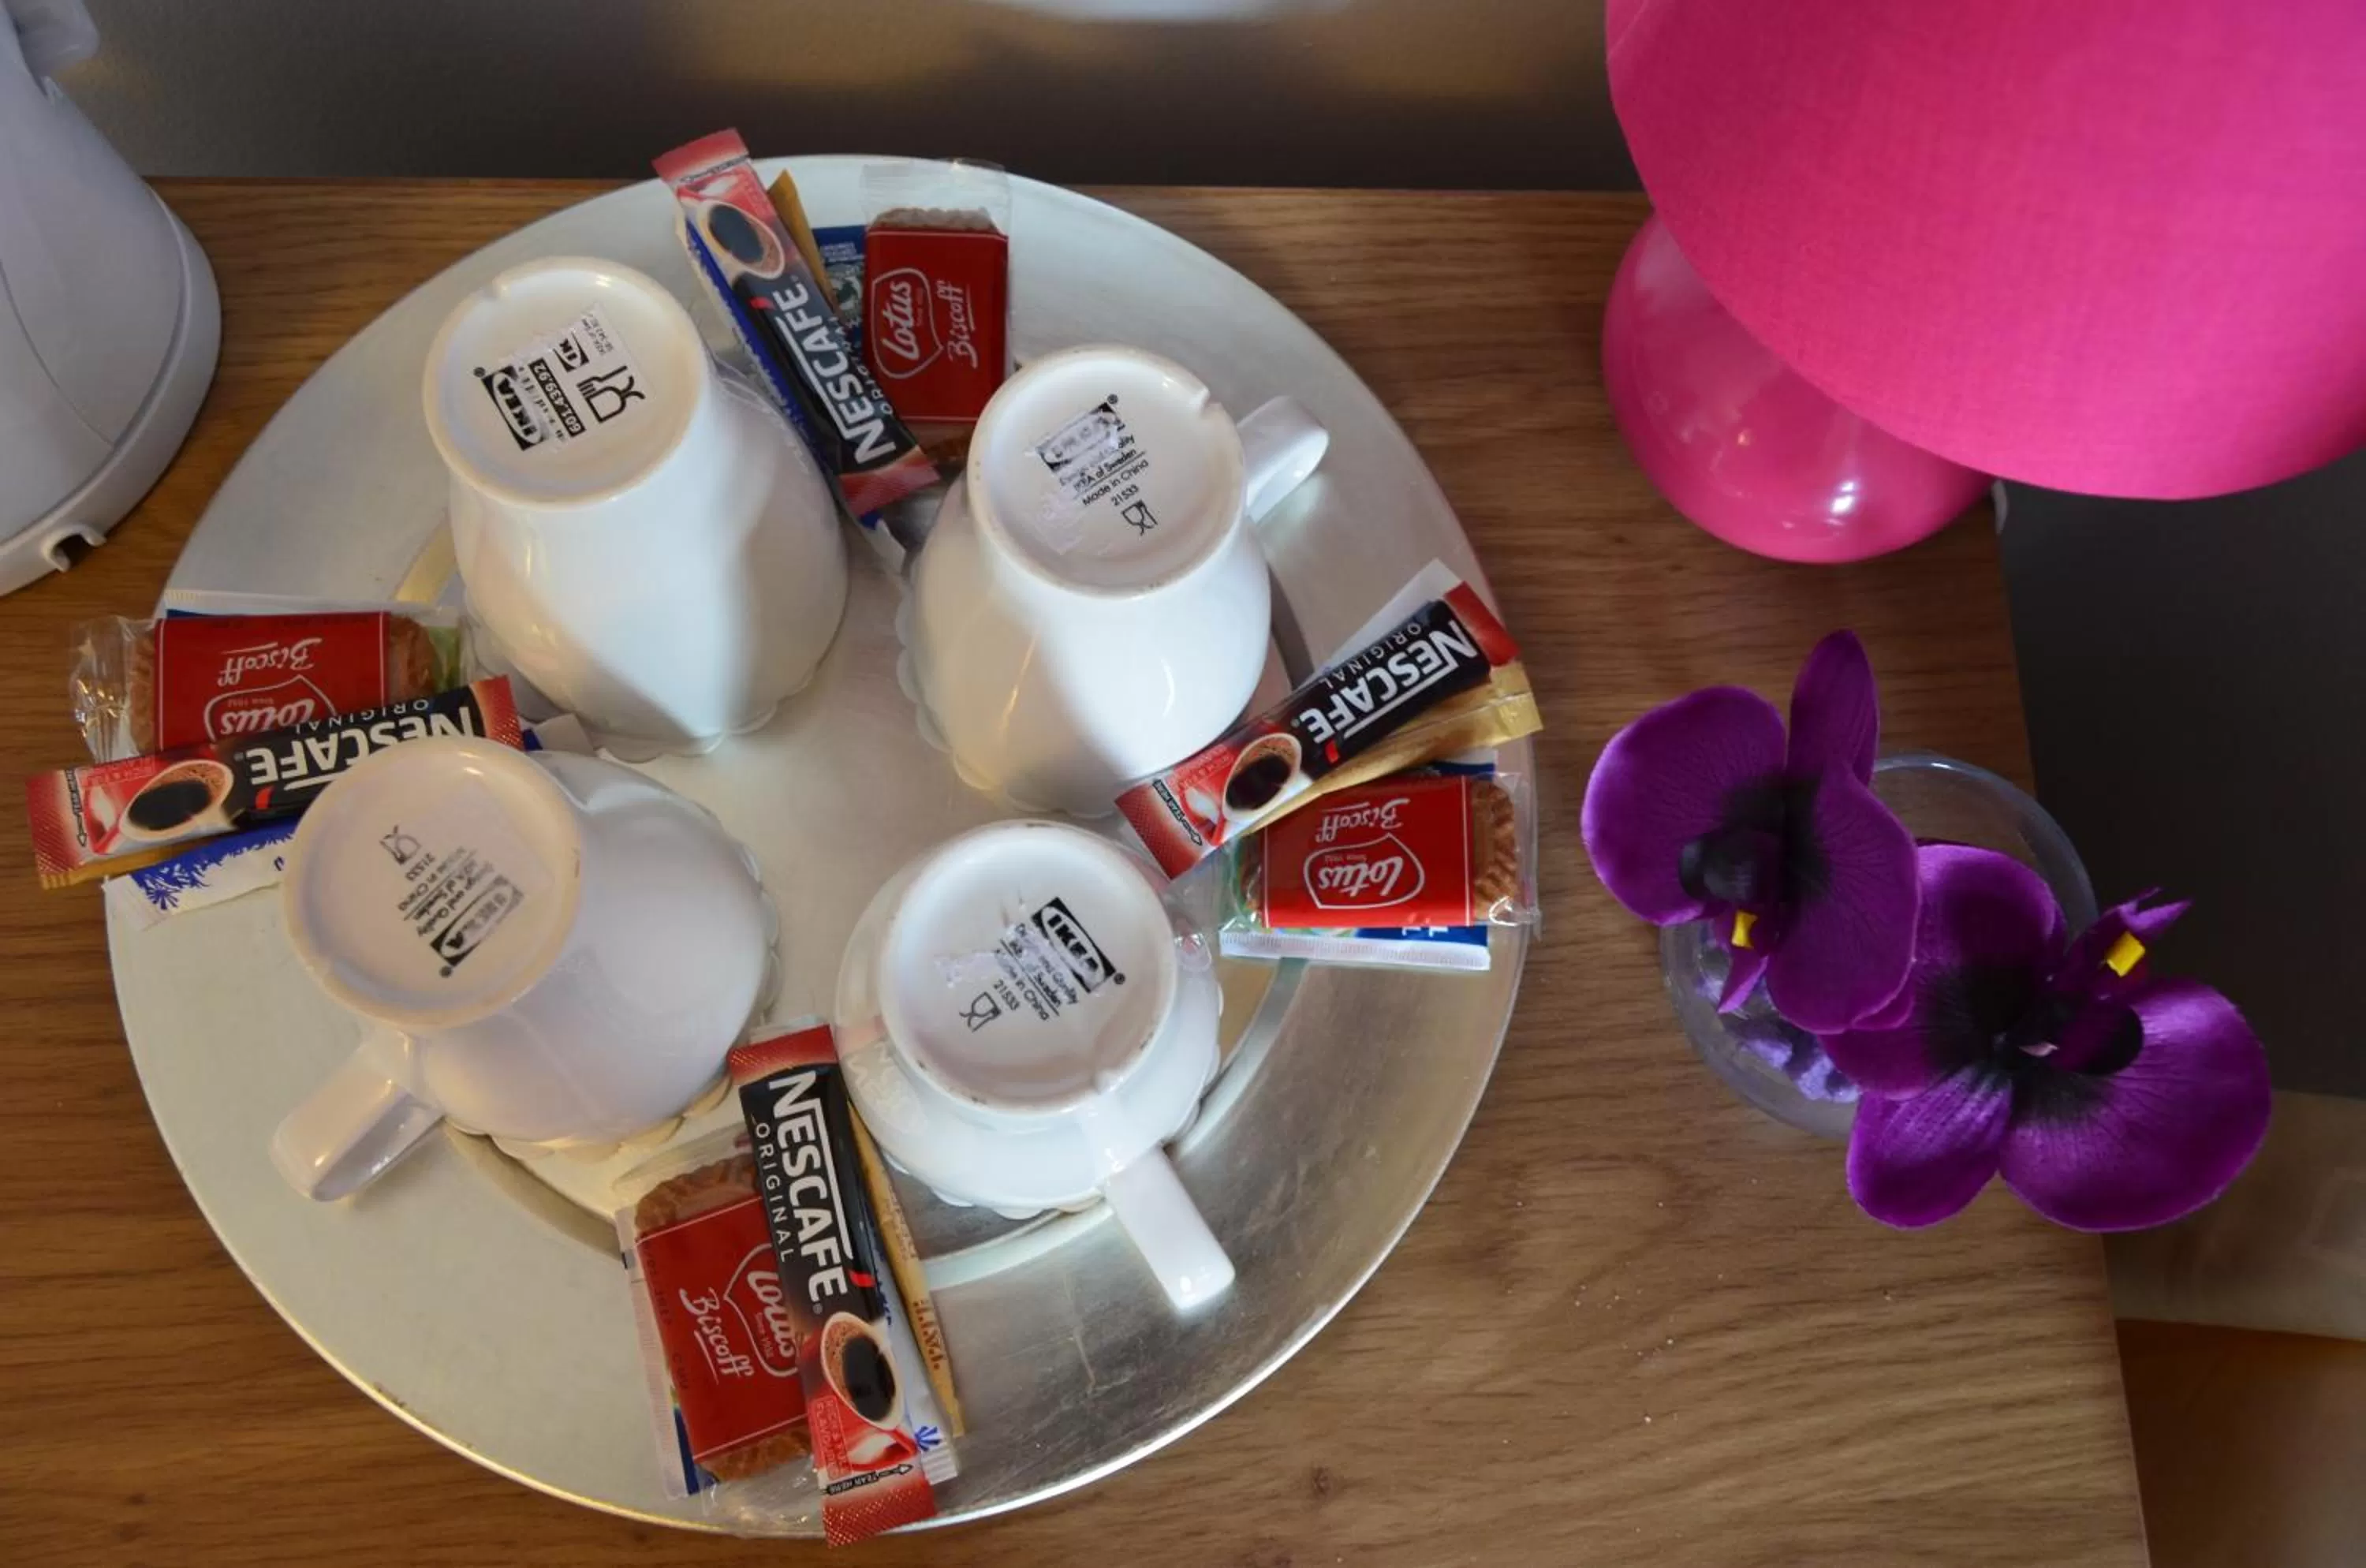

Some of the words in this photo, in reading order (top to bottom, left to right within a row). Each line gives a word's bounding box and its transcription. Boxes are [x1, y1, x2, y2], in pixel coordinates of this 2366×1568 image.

[879, 279, 921, 360] Lotus
[935, 278, 980, 368] Biscoff
[494, 375, 538, 439] IKEA
[532, 360, 582, 435] 601.439.92
[1080, 482, 1112, 506] Made
[1108, 476, 1121, 487] in
[1118, 457, 1149, 482] China
[1093, 466, 1105, 478] of
[1103, 445, 1137, 472] Sweden
[1110, 483, 1140, 507] 21533
[212, 634, 325, 687] Biscoff
[1315, 619, 1426, 693] ORIGINAL
[217, 697, 317, 736] Lotus
[1314, 796, 1410, 843] Biscoff
[402, 850, 436, 883] 21533
[425, 872, 439, 886] in
[443, 878, 458, 893] of
[1317, 854, 1403, 898] Lotus
[394, 880, 431, 915] China
[411, 887, 449, 924] Sweden
[445, 888, 468, 911] and
[412, 905, 451, 940] Quality
[1045, 913, 1102, 976] IKEA
[991, 978, 1022, 1011] 21533
[1013, 977, 1028, 991] in
[1021, 987, 1052, 1021] China
[1032, 971, 1065, 1008] Sweden
[752, 1120, 797, 1264] ORIGINAL
[677, 1279, 755, 1383] Biscoff
